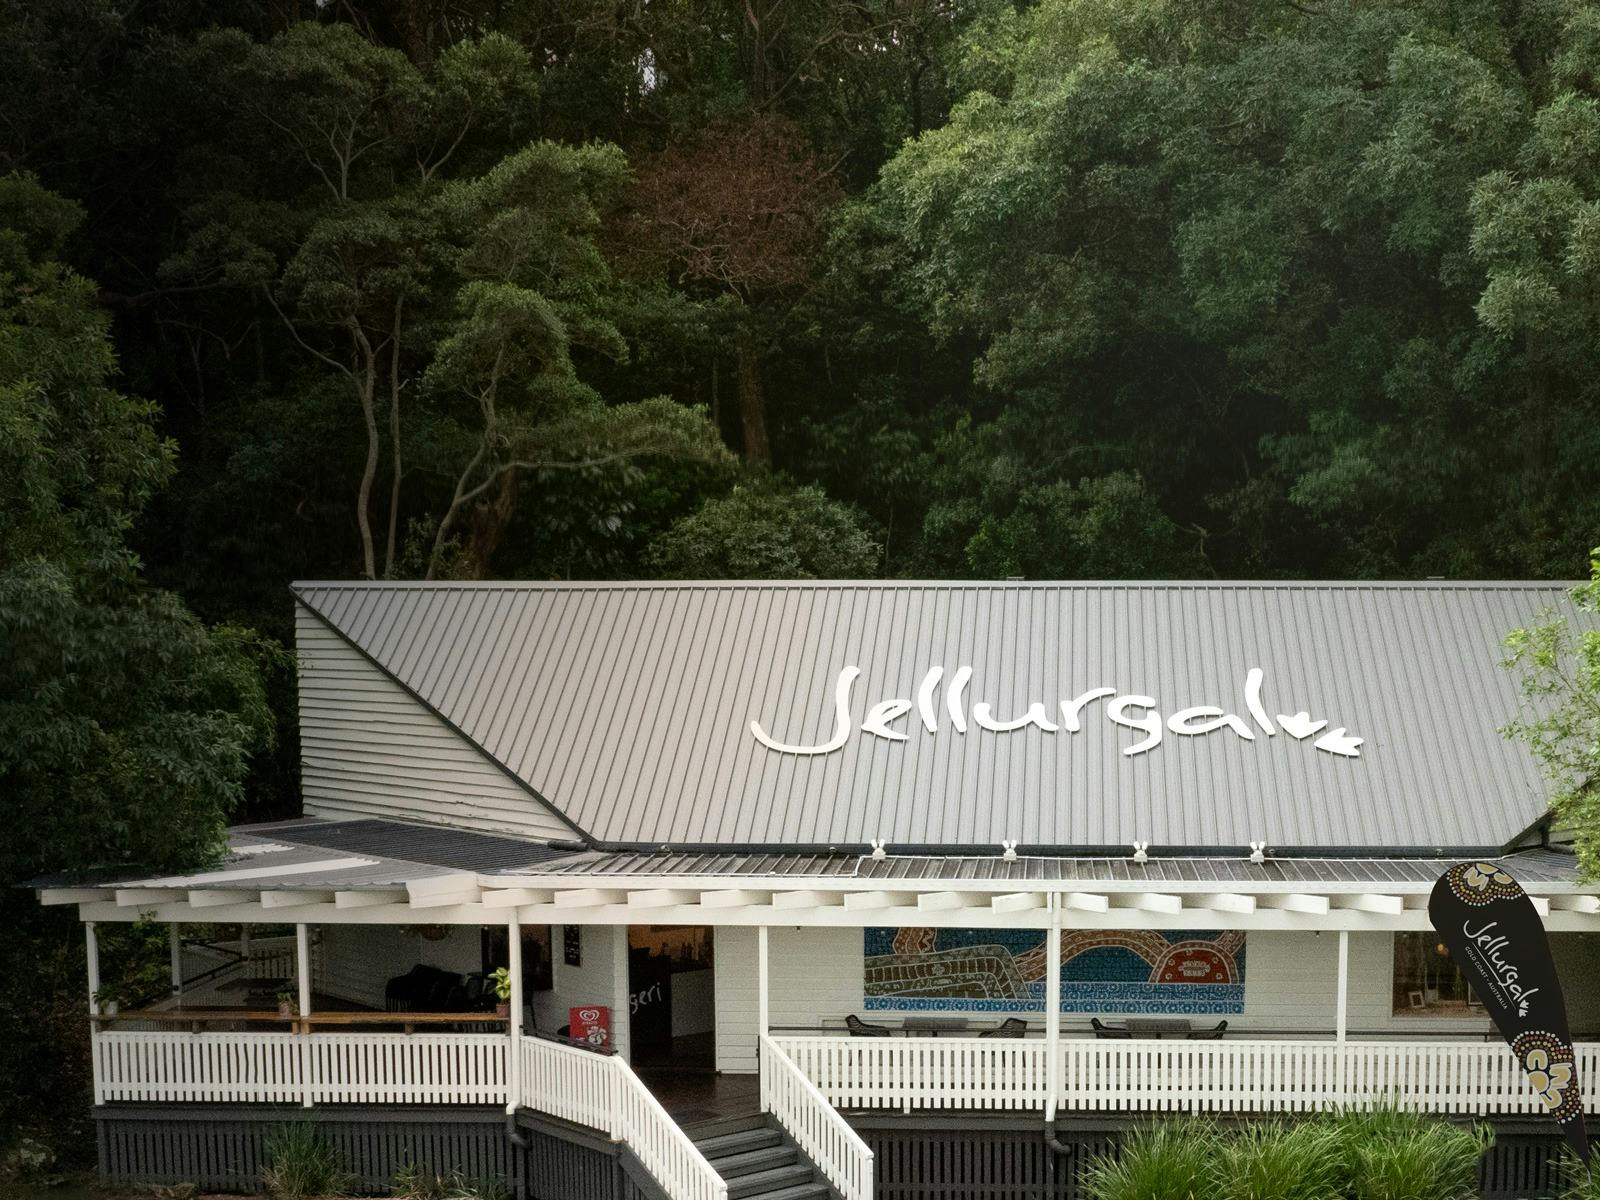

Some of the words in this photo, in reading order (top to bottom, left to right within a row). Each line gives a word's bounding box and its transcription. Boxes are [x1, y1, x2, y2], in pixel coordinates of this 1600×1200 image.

[750, 666, 1276, 757] Jellurgal
[1463, 919, 1539, 1002] Jellurgal
[1464, 946, 1477, 961] GOLD
[1474, 961, 1489, 978] COAST
[1487, 982, 1508, 1010] AUSTRALIA
